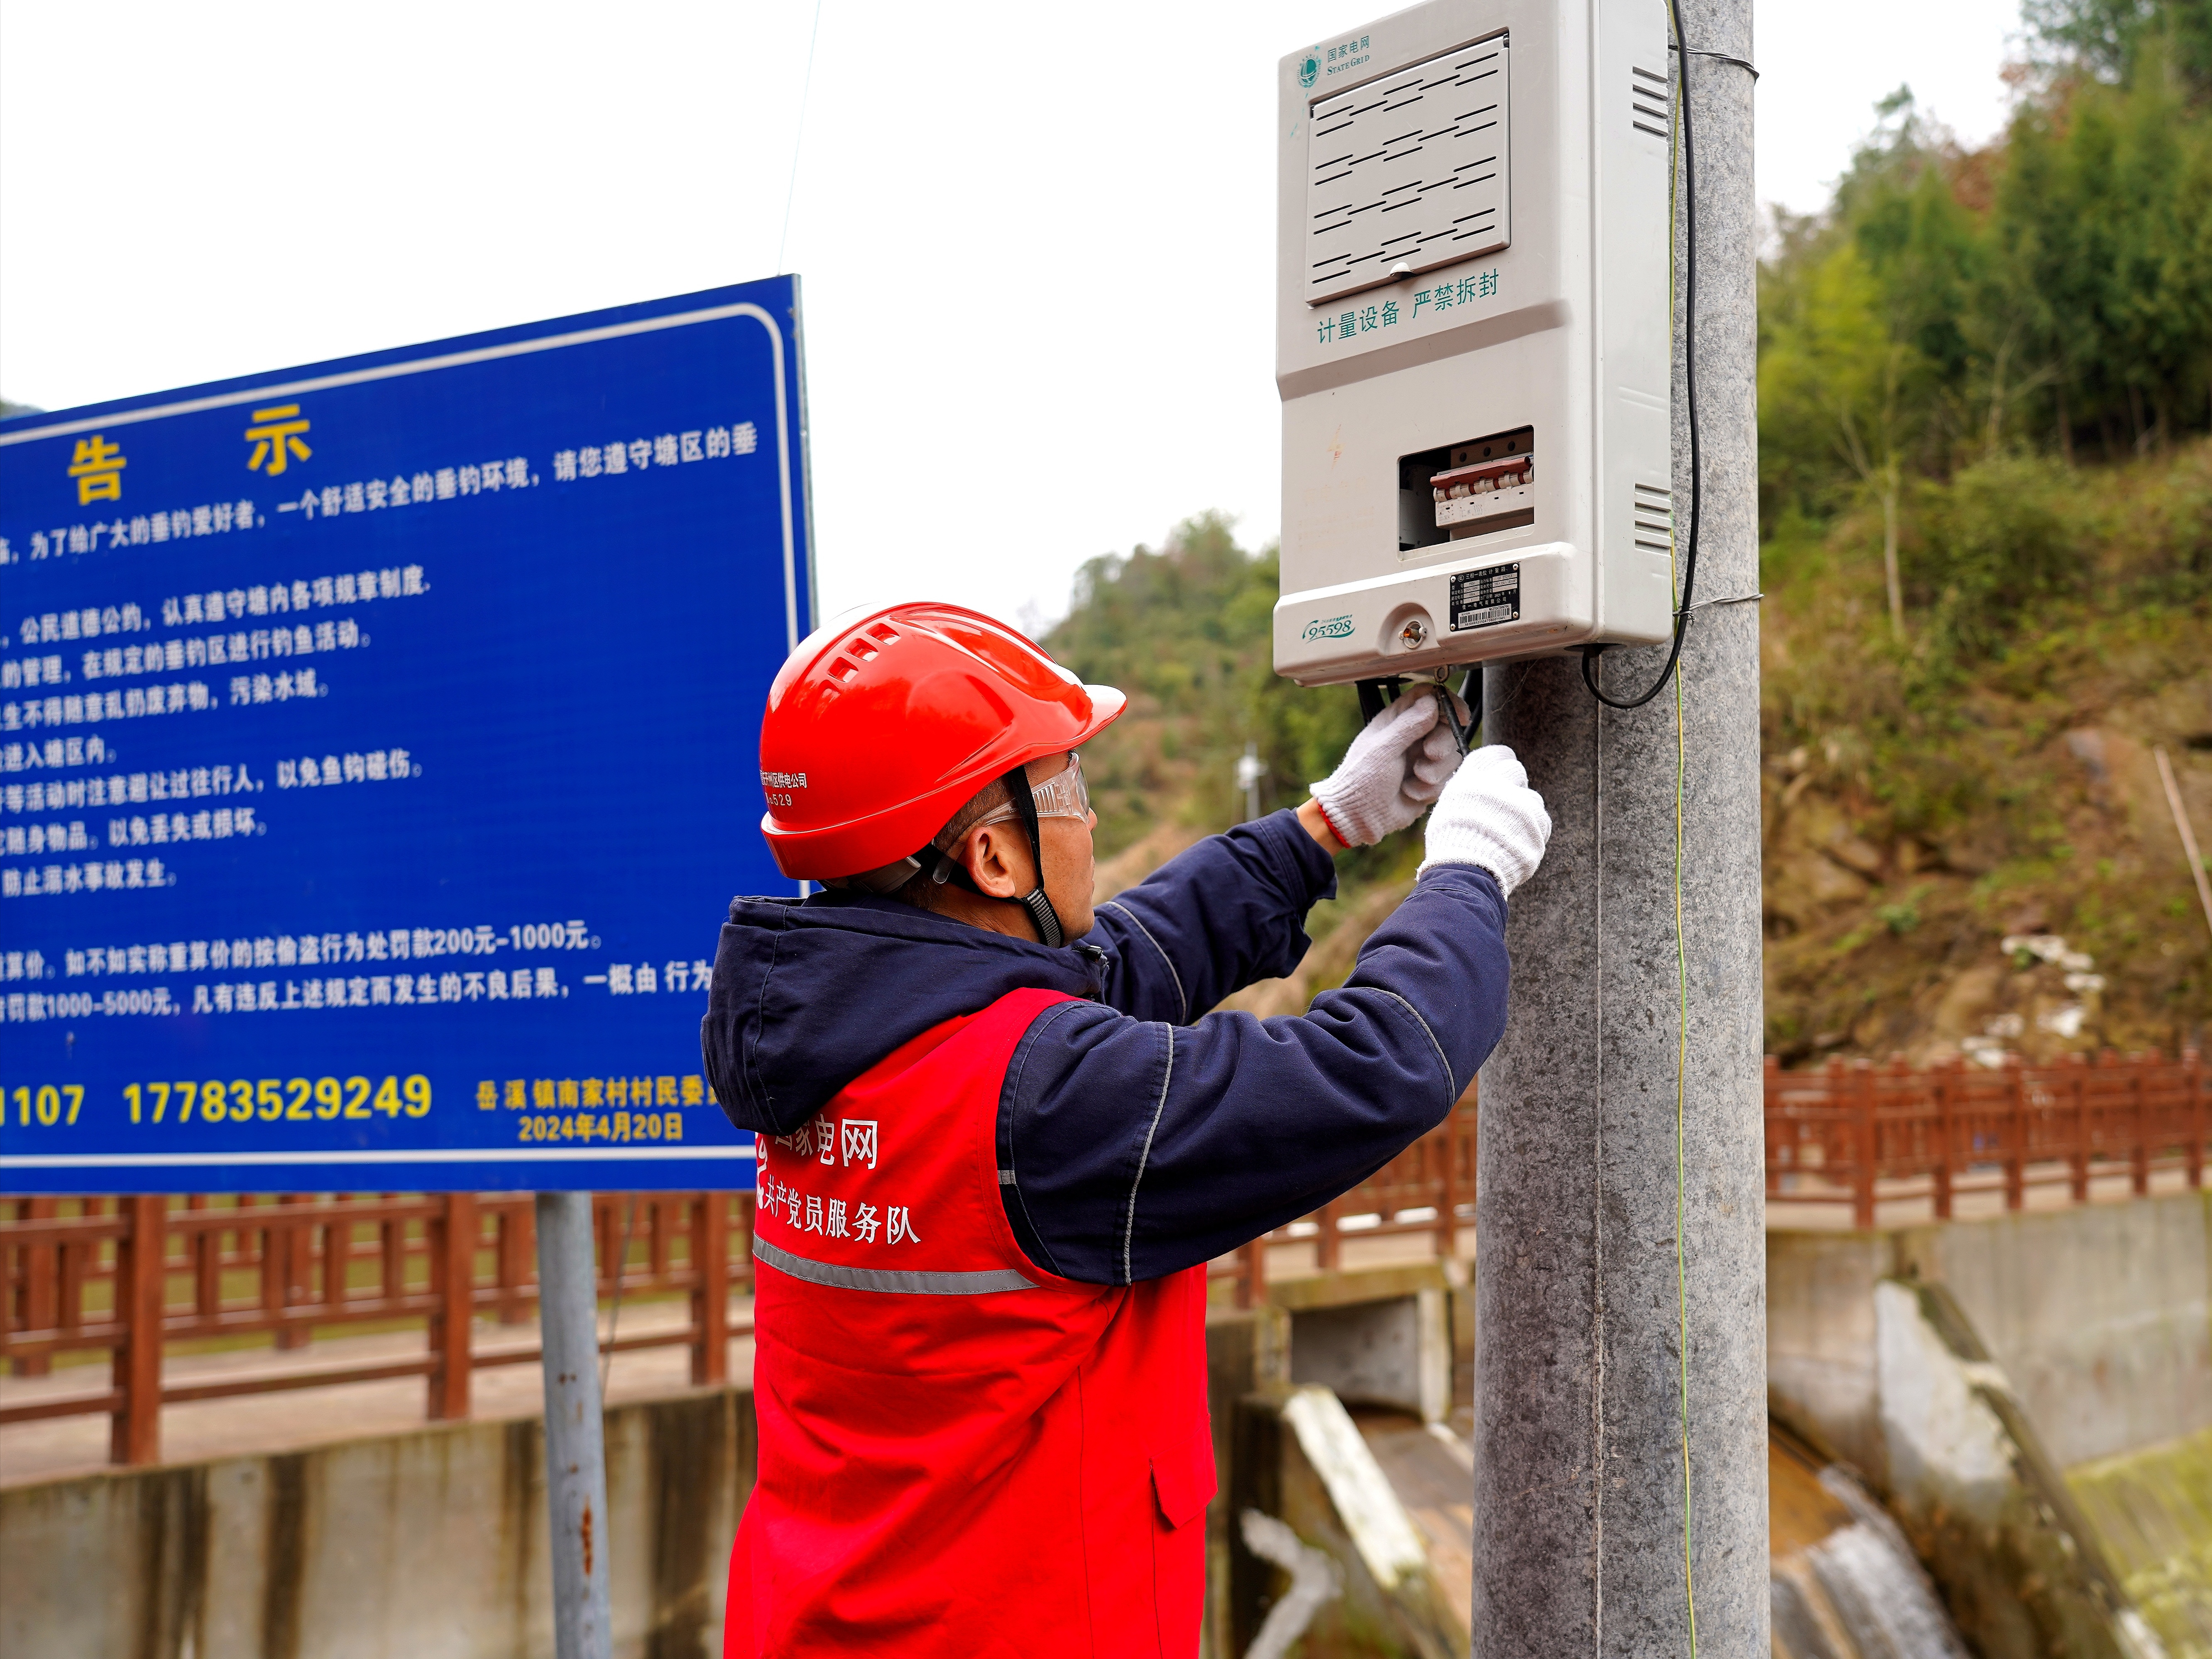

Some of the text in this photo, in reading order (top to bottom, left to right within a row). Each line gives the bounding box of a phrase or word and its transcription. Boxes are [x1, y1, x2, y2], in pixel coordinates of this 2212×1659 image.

[1327, 35, 1369, 63] 国家电网
[1327, 55, 1369, 76] STATE GRID
[1317, 268, 1499, 343] 计量设备 严禁拆封
[67, 404, 312, 505] 告 示
[1309, 620, 1351, 640] 95598
[0, 668, 328, 731] 生不得随意乱扔废弃物，污染水域。
[0, 735, 117, 772] 进入塘区内。
[0, 807, 267, 856] 随身物品。以免丢失或损坏。
[123, 1073, 432, 1124] 17783529249
[518, 1111, 683, 1143] 2024年4月20日
[765, 1174, 921, 1245] 共产党员服务队
